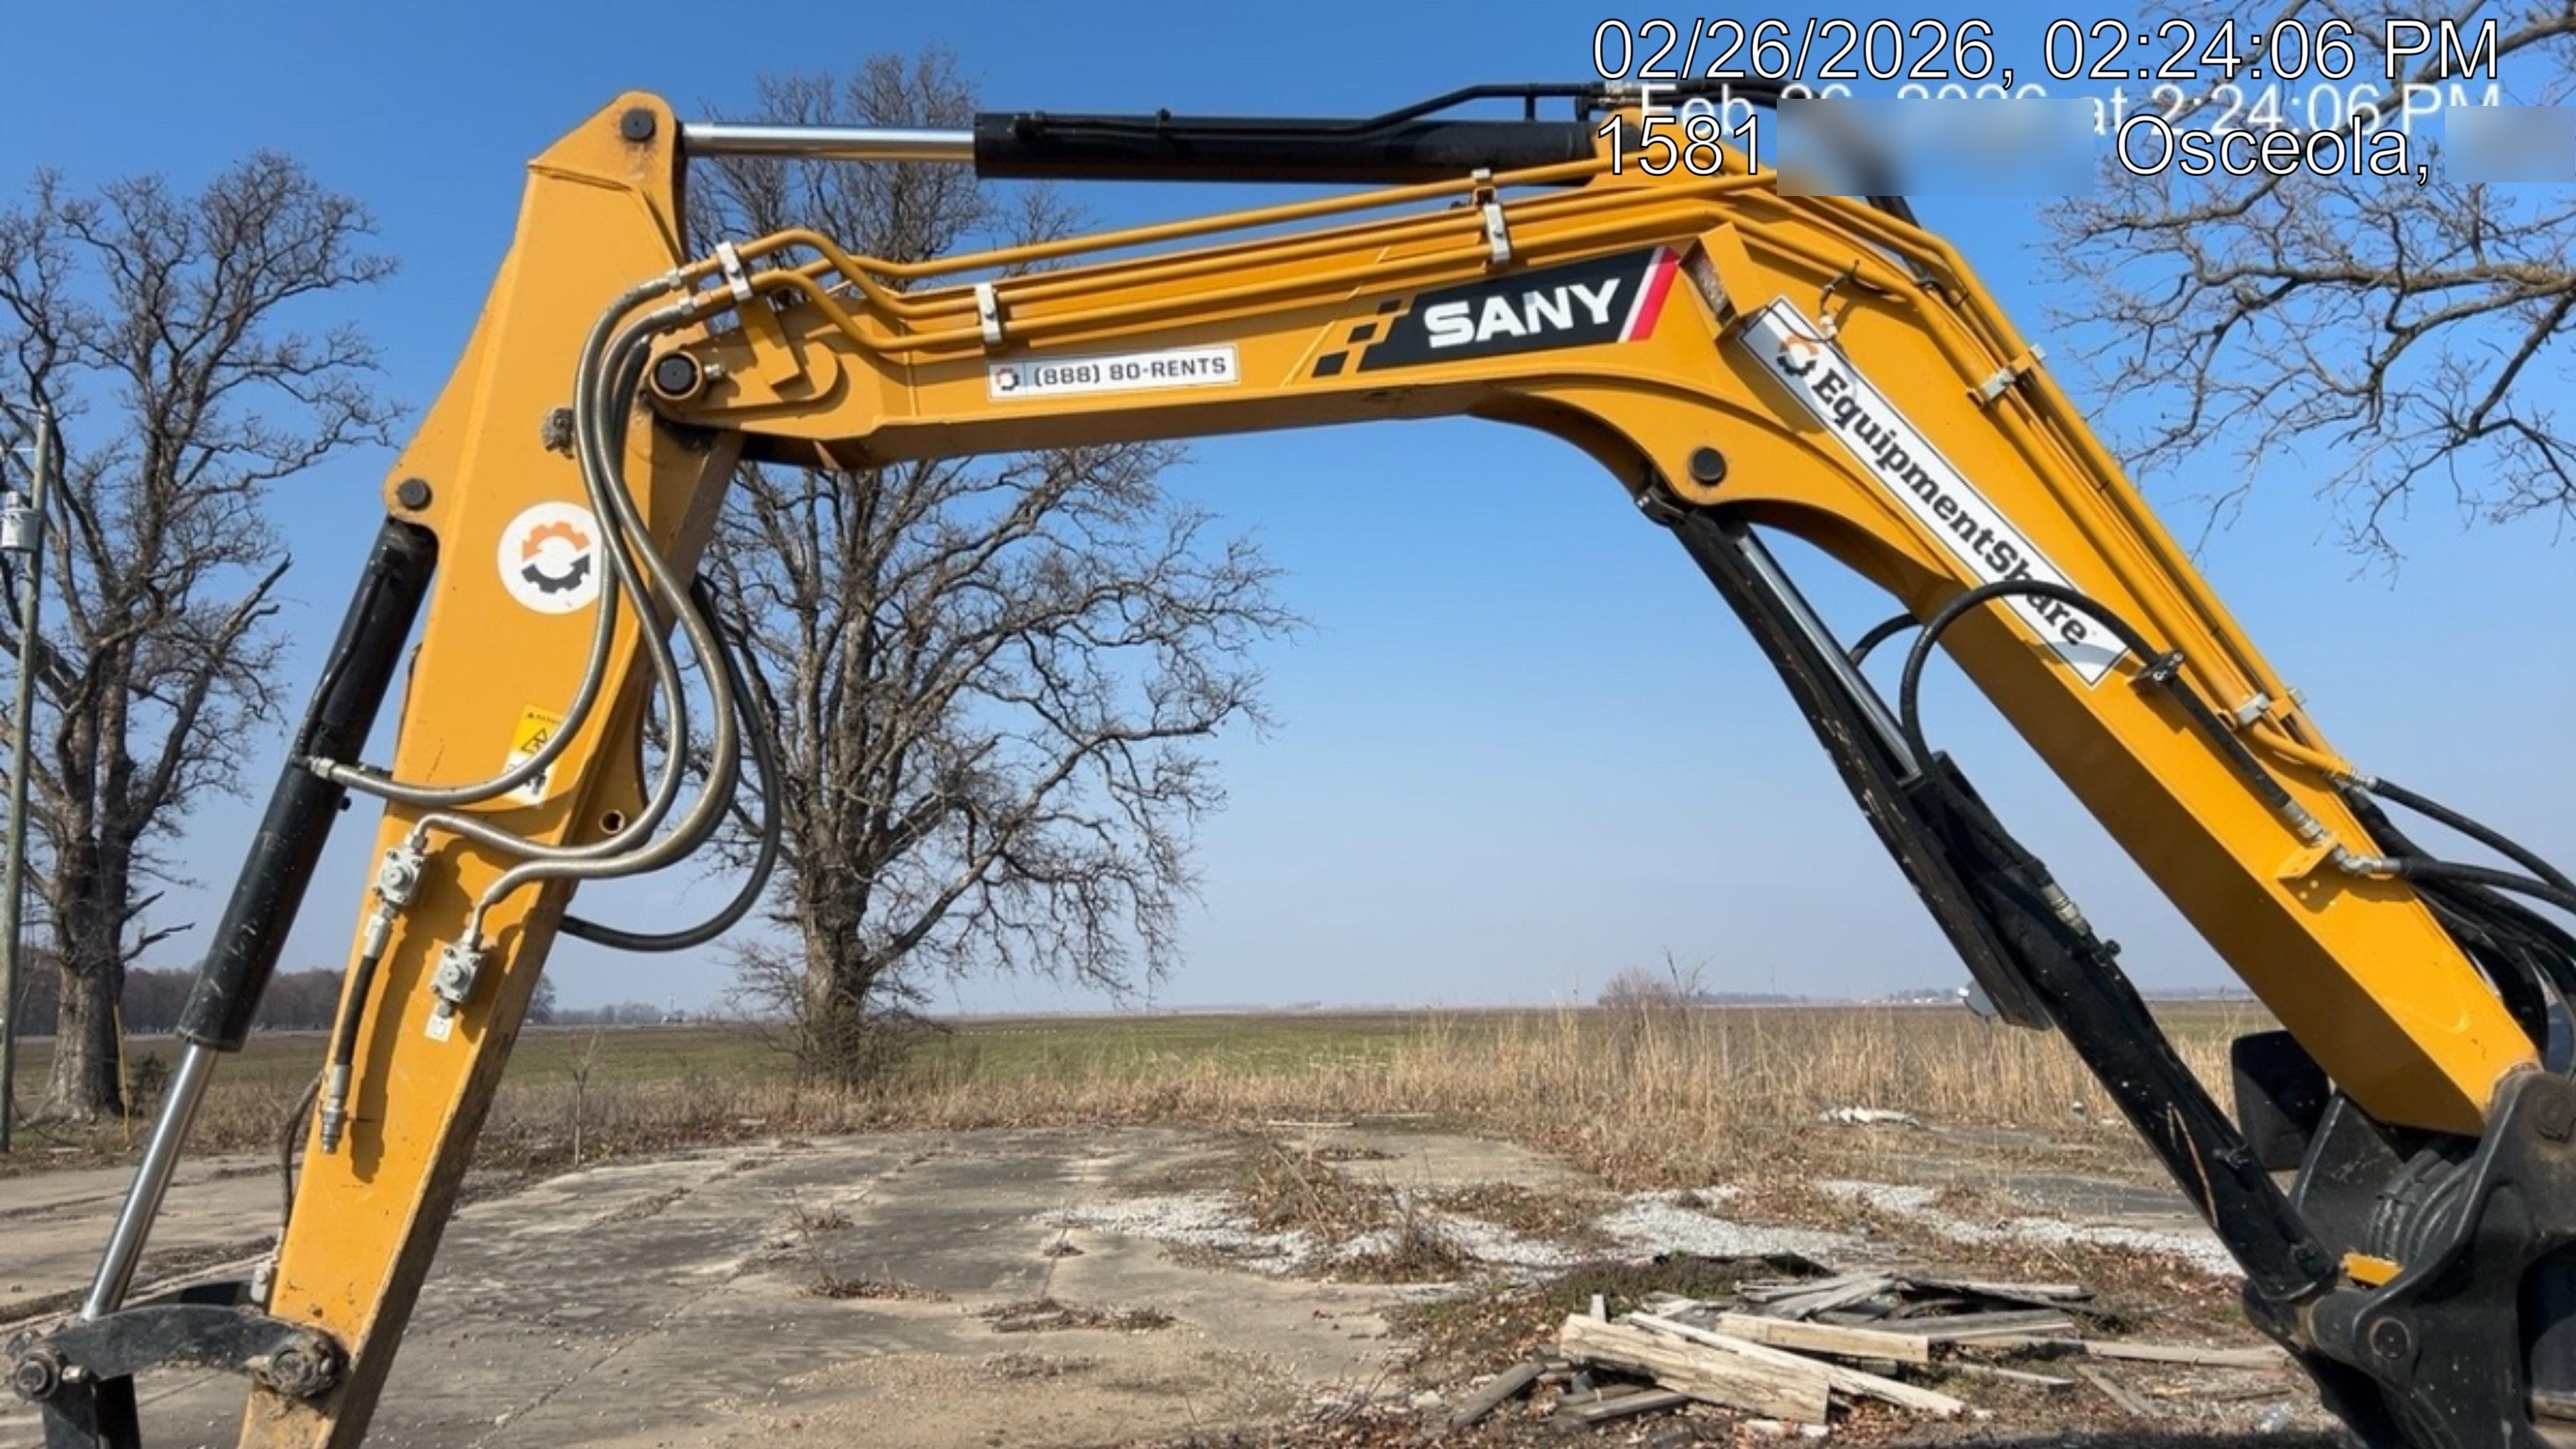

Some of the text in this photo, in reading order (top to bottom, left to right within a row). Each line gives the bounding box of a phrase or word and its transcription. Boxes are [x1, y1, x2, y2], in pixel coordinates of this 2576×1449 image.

[1423, 278, 1621, 348] SANY
[1034, 356, 1226, 387] (888) 80-RENTS
